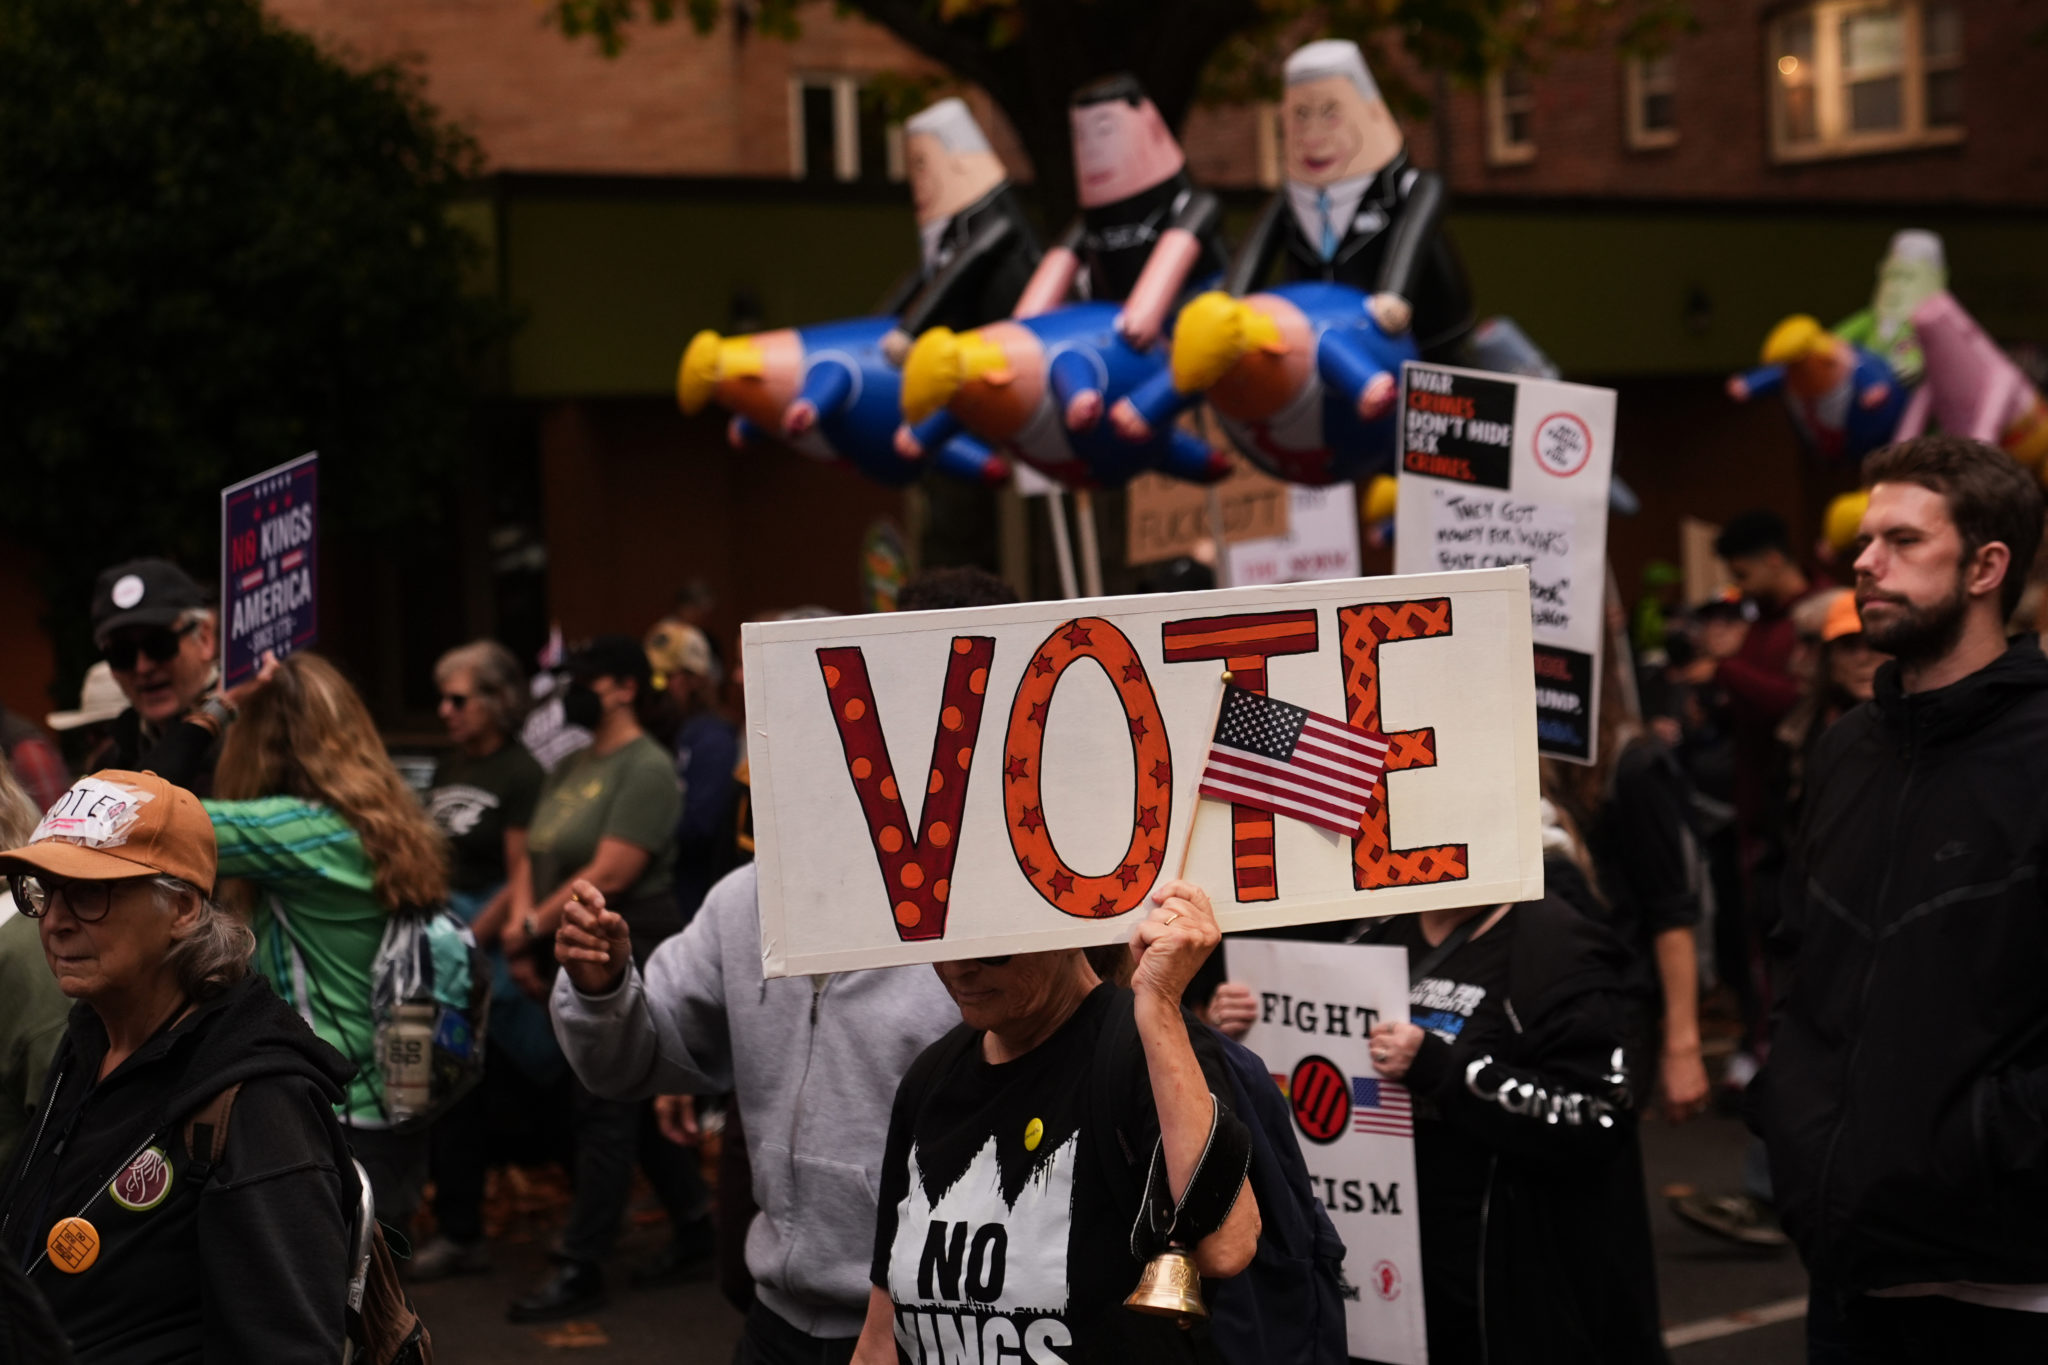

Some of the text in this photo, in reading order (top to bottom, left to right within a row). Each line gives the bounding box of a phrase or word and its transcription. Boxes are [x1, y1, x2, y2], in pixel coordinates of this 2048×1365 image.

[1408, 390, 1475, 419] CRIMES
[1410, 371, 1454, 394] WAR
[1407, 411, 1465, 439] DON'T
[1467, 419, 1512, 447] HIDE
[1407, 432, 1439, 454] SEX
[260, 503, 311, 558] KINGS
[231, 567, 313, 641] AMERICA
[816, 597, 1470, 942] VOTE
[1260, 992, 1380, 1040] FIGHT
[917, 1219, 1008, 1304] NO
